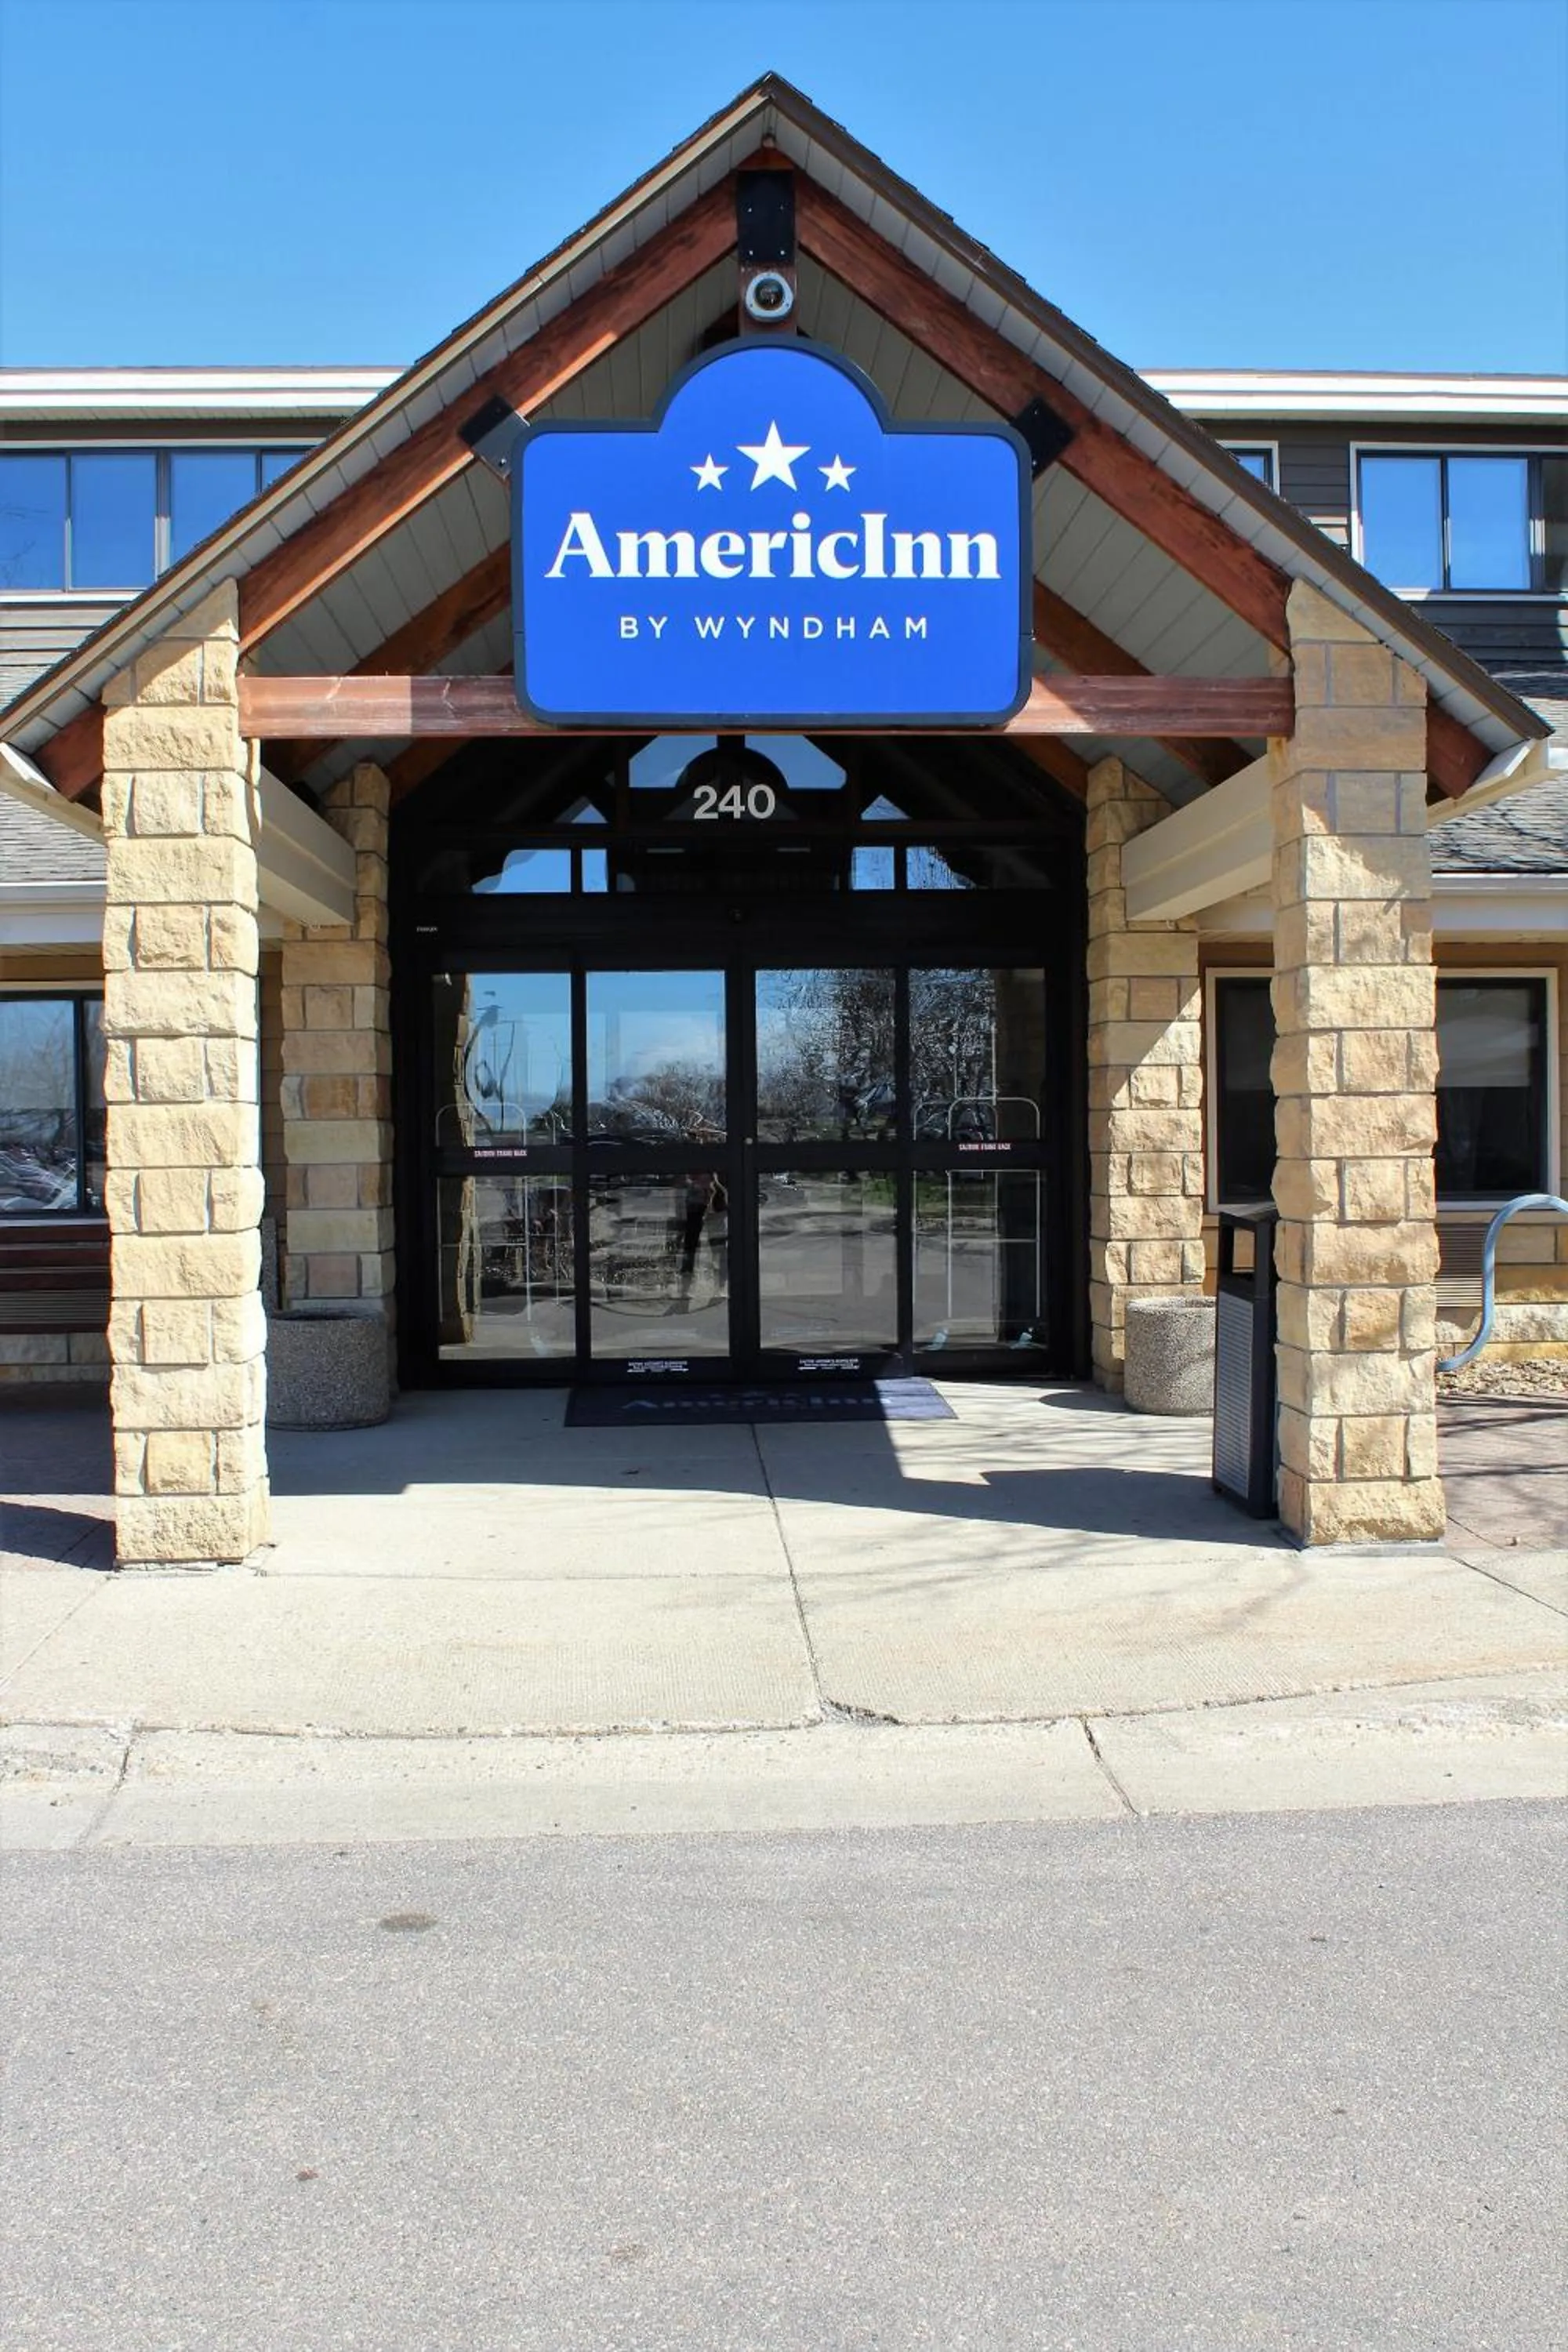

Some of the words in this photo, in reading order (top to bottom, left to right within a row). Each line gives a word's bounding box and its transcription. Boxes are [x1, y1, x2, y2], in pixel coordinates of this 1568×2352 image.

[544, 512, 1001, 579] AmericInn
[620, 617, 667, 638] BY
[694, 617, 927, 639] WYNDHAM
[693, 784, 775, 819] 240
